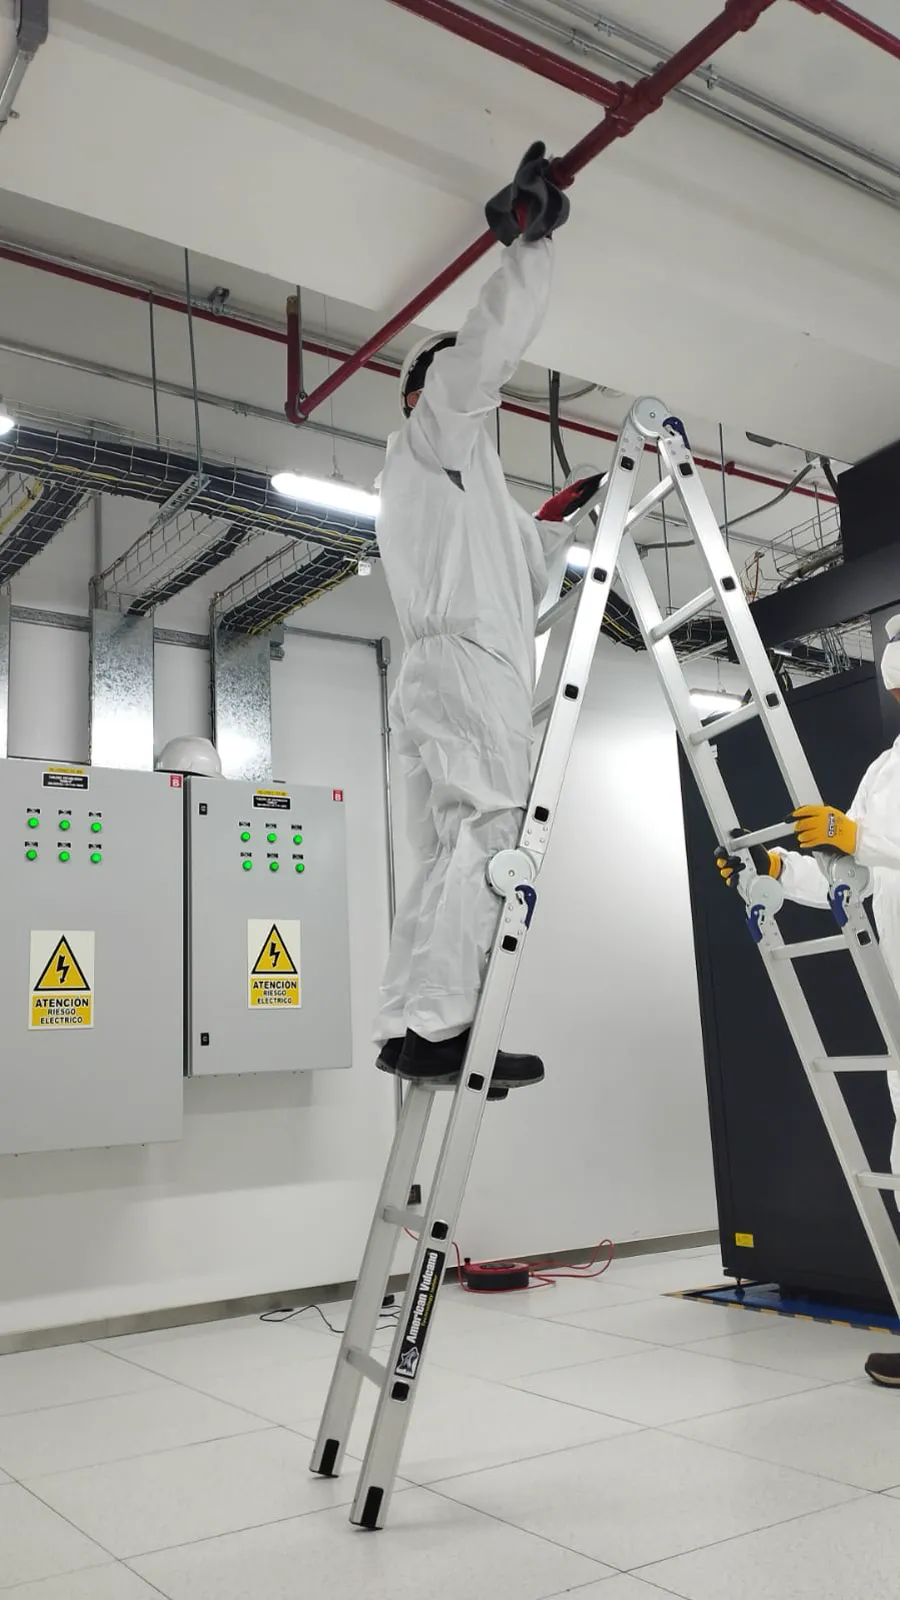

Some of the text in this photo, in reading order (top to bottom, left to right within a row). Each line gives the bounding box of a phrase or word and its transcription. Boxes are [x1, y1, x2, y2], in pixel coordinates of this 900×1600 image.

[35, 997, 89, 1007] ATENCIÓN
[406, 1252, 438, 1343] American Vulcano
